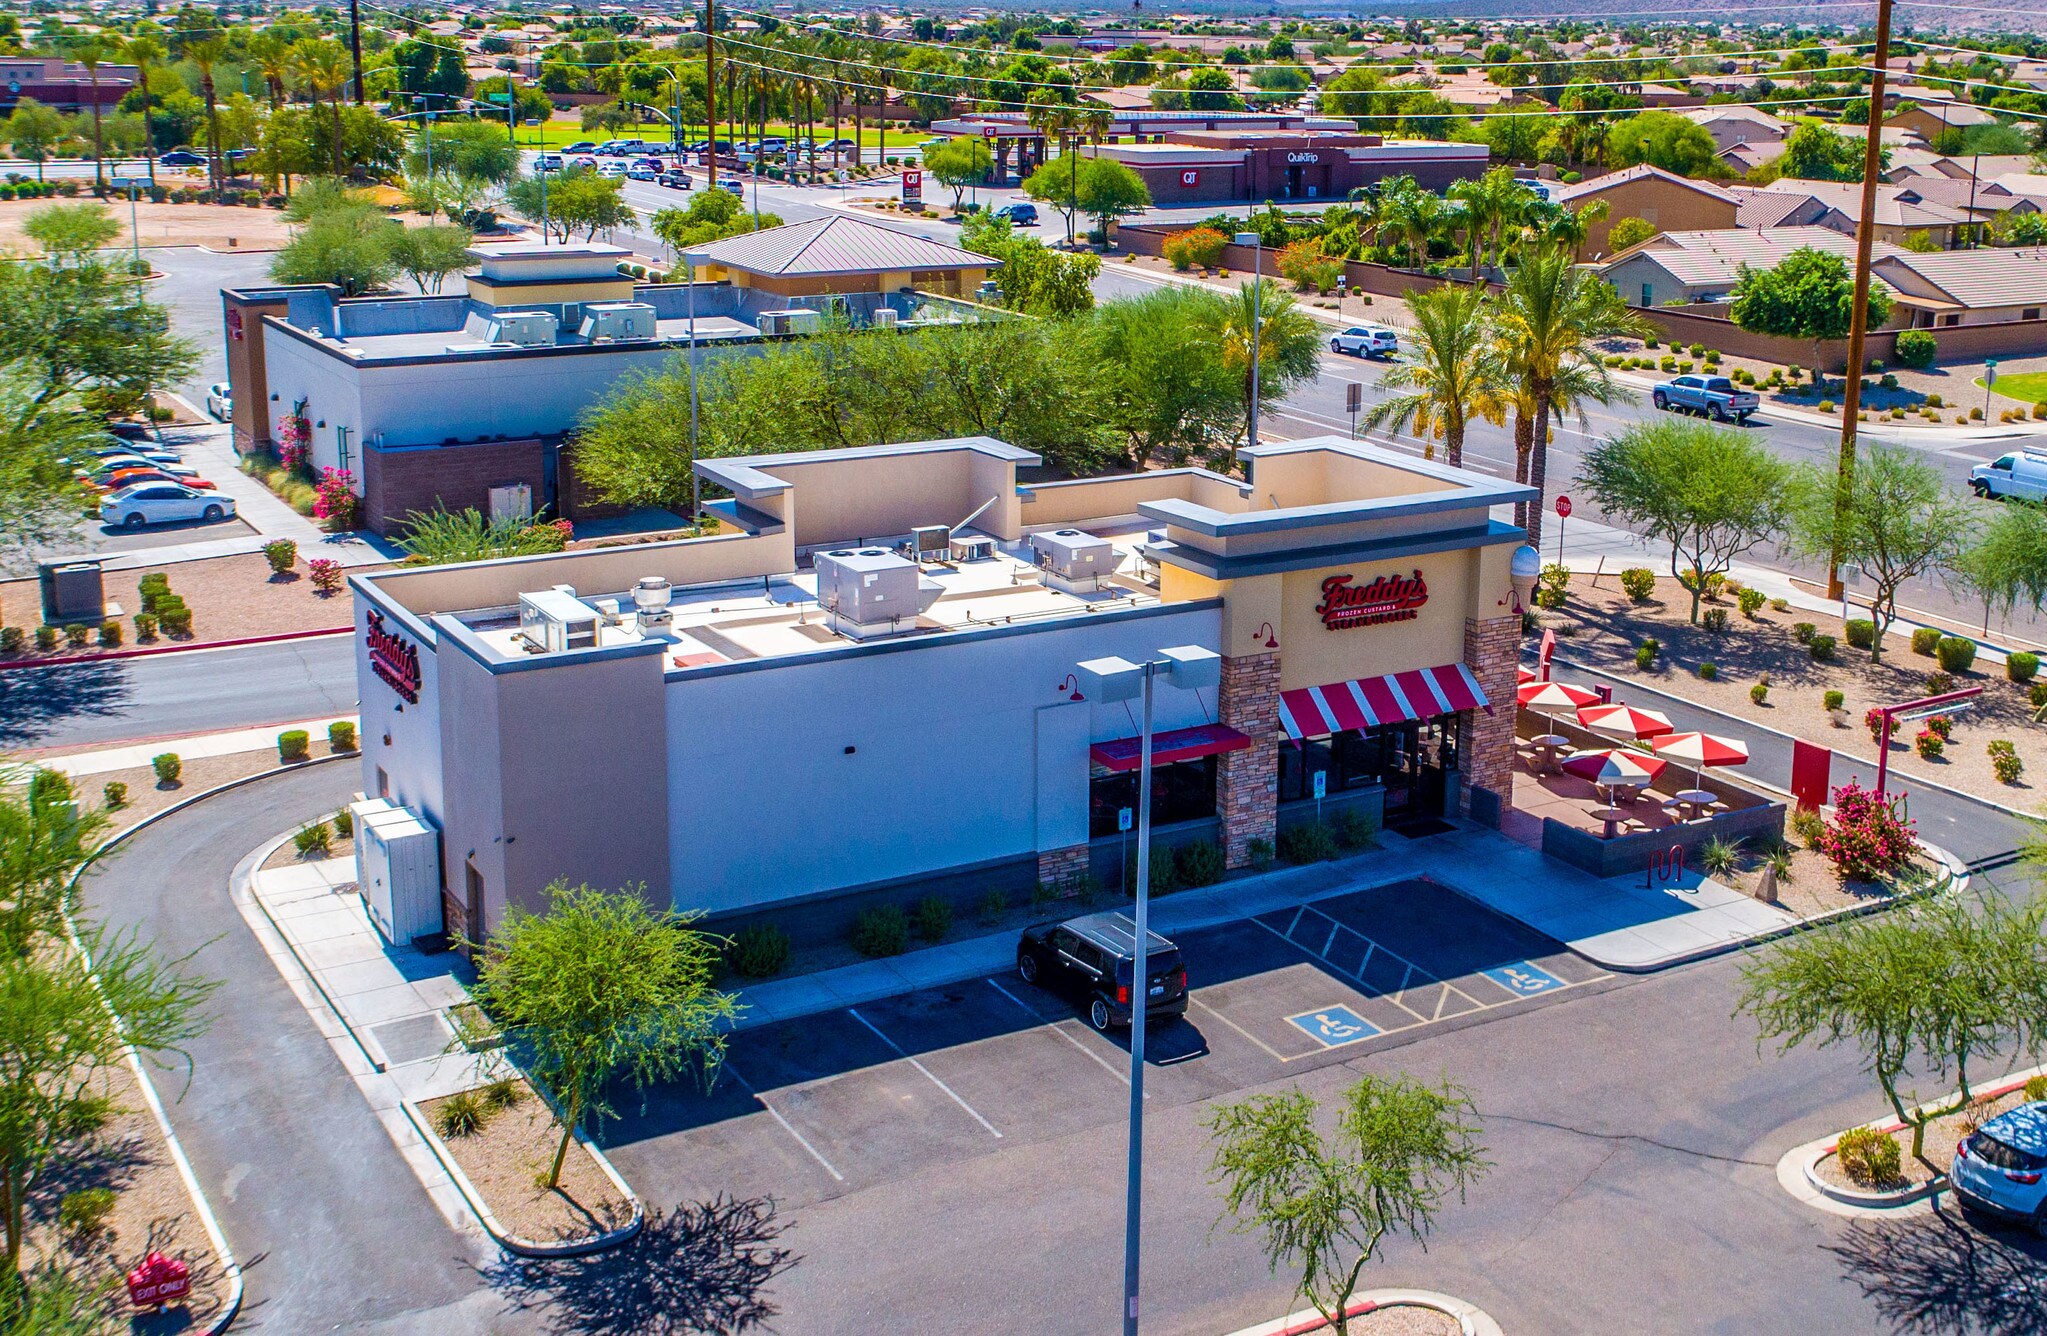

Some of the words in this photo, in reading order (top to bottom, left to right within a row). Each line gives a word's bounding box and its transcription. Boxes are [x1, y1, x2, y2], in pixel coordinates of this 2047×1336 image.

[1288, 152, 1318, 164] QuikTrip
[907, 173, 919, 184] QT
[1183, 171, 1197, 184] QT
[1557, 501, 1571, 511] STOP
[1315, 569, 1429, 615] Freddy's
[1337, 608, 1362, 617] FROZEN
[1363, 604, 1391, 614] CUSTARD
[137, 1285, 157, 1299] EXIT
[160, 1278, 185, 1294] ONLY
